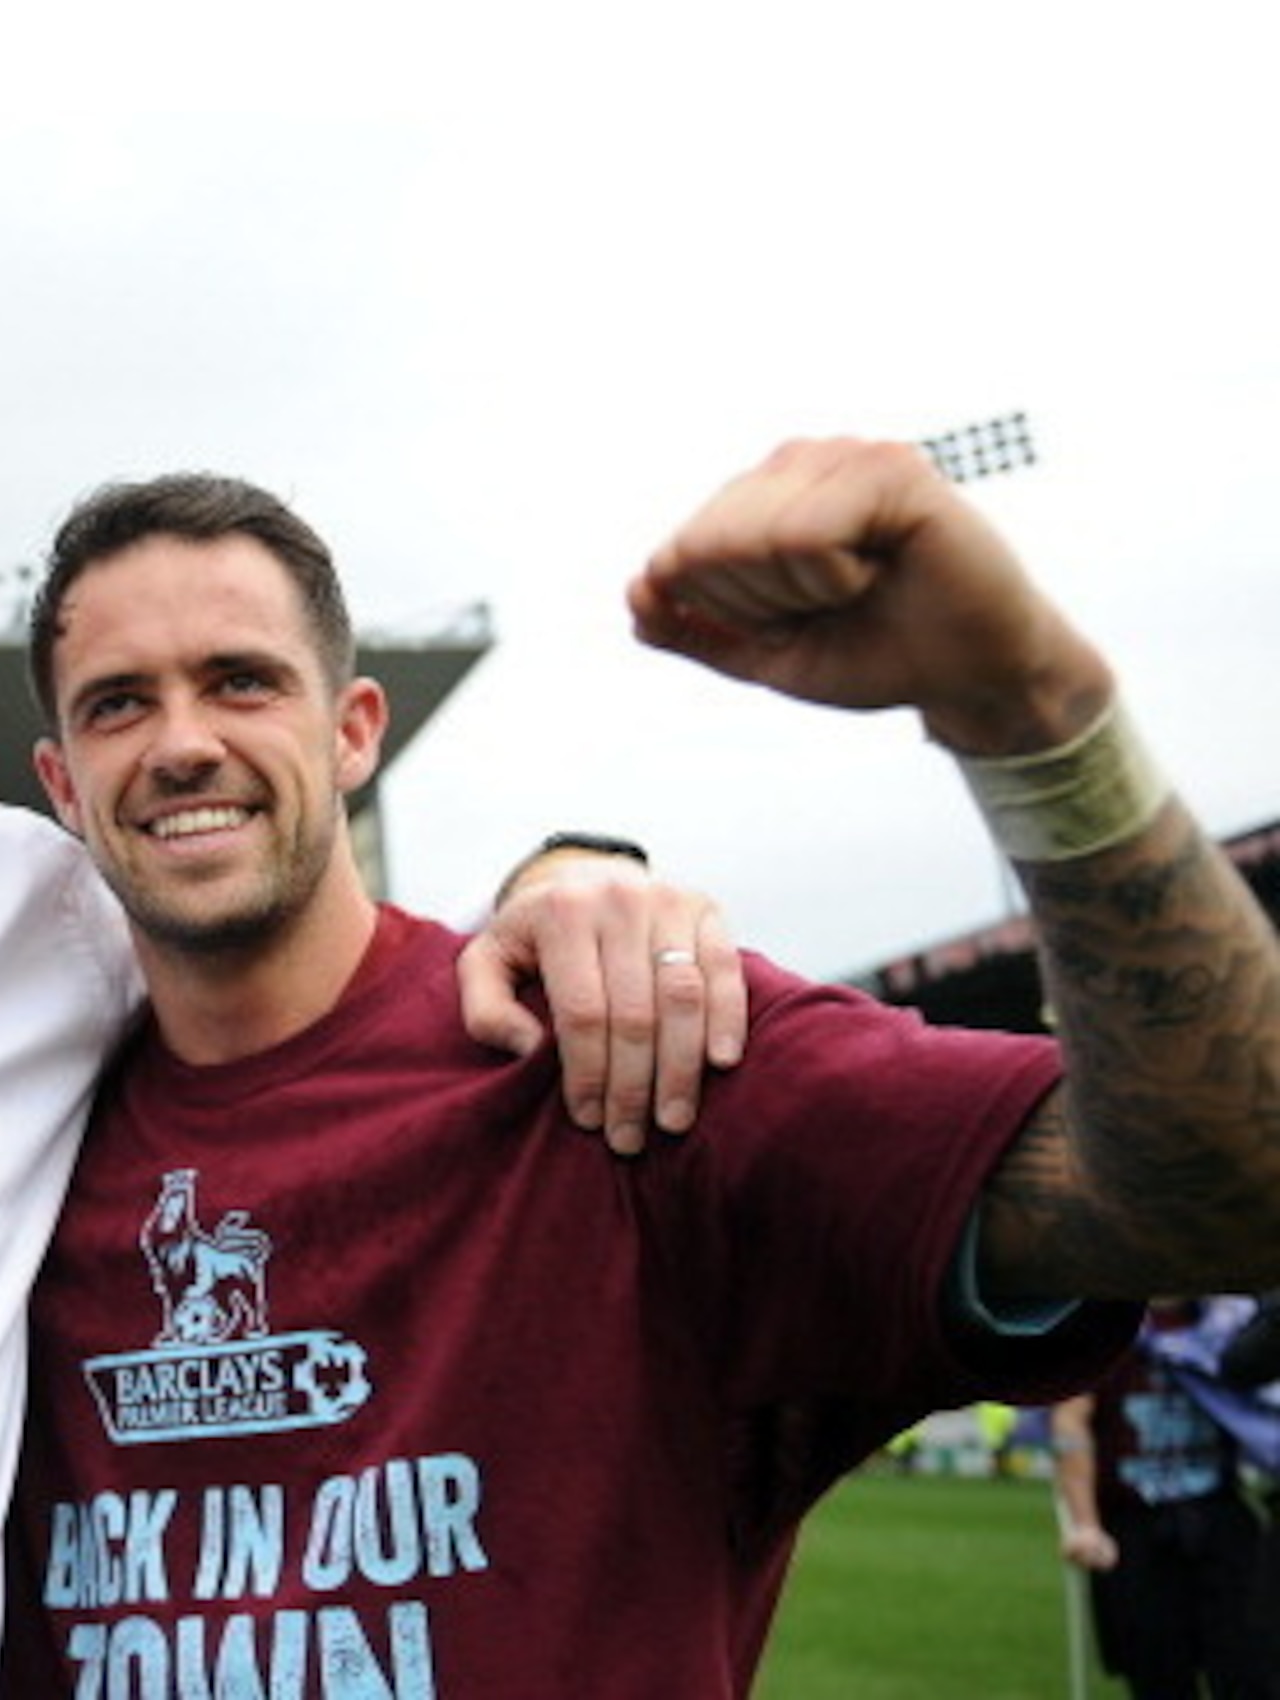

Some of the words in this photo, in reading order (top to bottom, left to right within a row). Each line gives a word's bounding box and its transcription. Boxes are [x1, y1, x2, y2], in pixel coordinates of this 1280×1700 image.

[116, 1350, 284, 1404] BARCLAYS
[193, 1484, 284, 1599] IN
[302, 1453, 488, 1591] OUR
